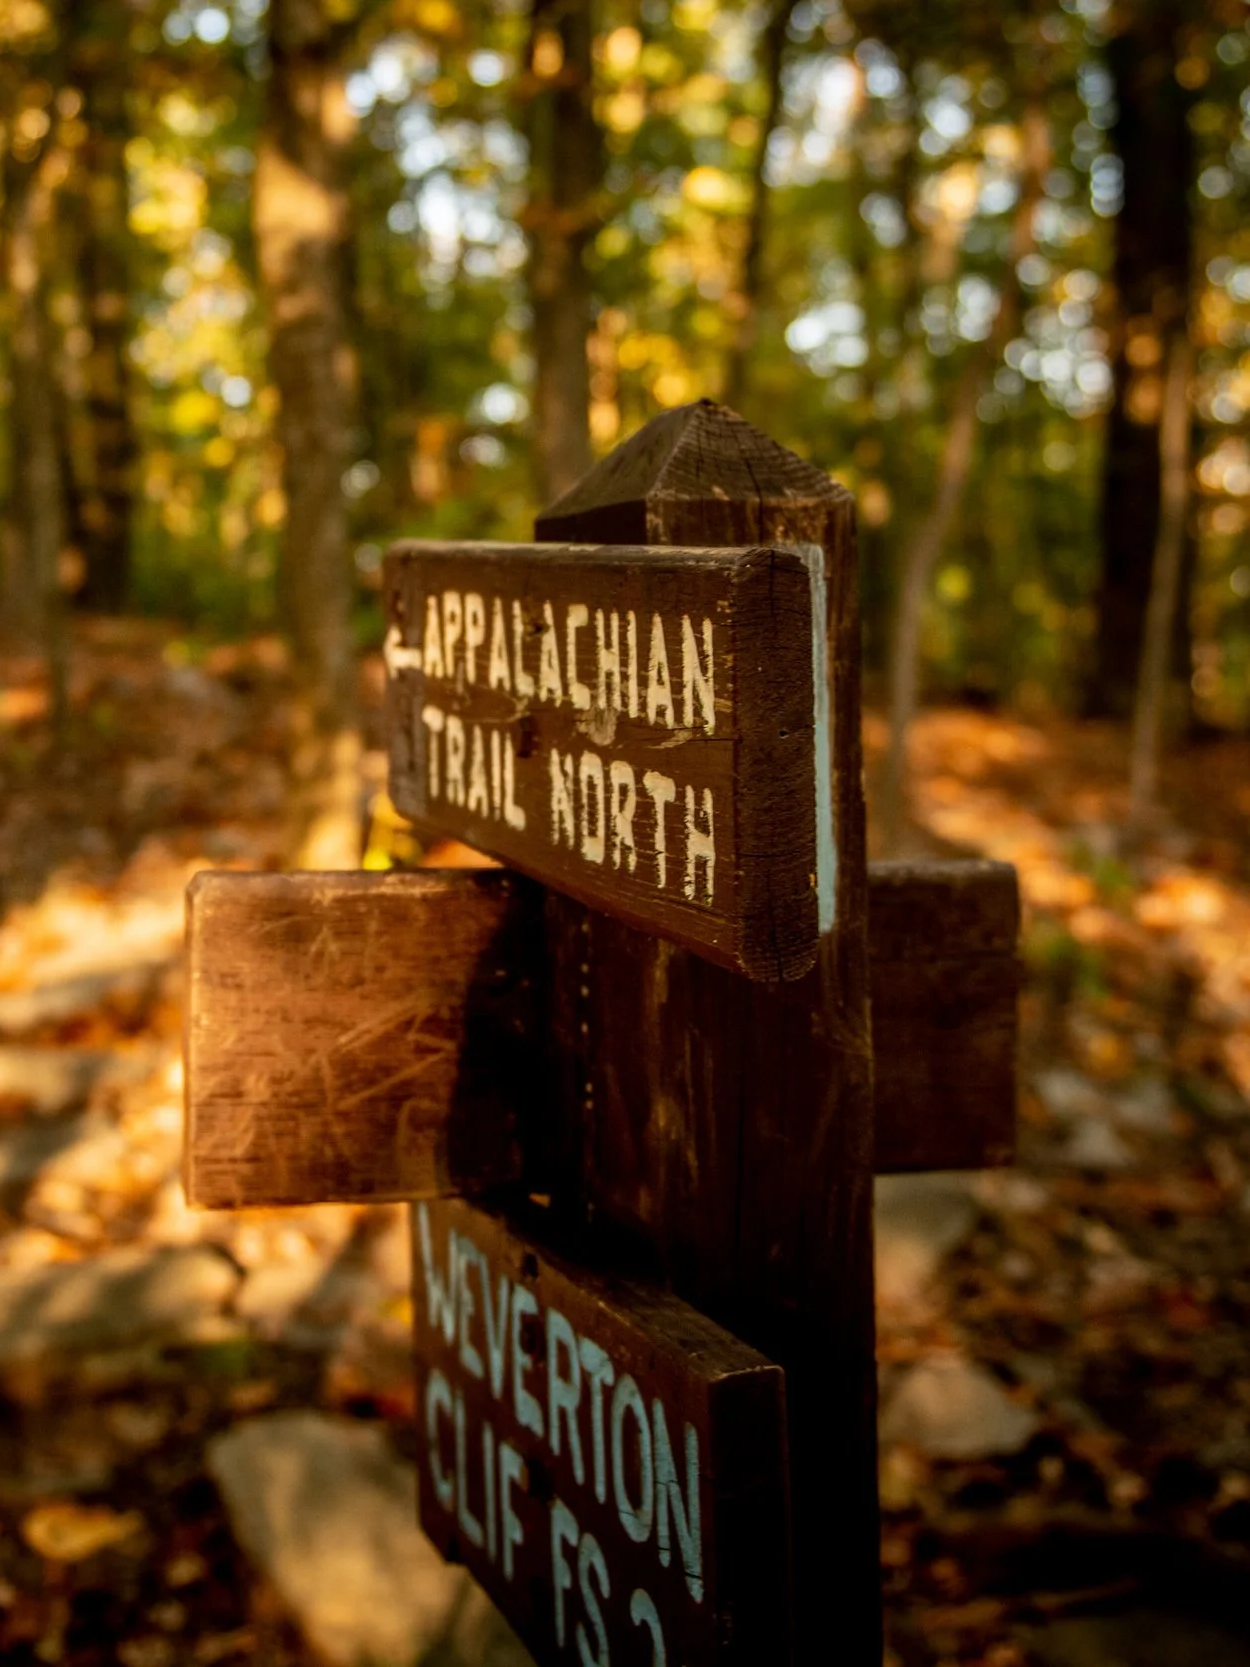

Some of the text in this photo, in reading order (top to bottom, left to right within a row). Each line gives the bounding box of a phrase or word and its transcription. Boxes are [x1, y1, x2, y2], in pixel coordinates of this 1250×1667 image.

[423, 591, 715, 735] APPALACHIAN
[422, 705, 716, 907] TRAIL NORTH
[417, 1201, 704, 1604] WEVERTON
